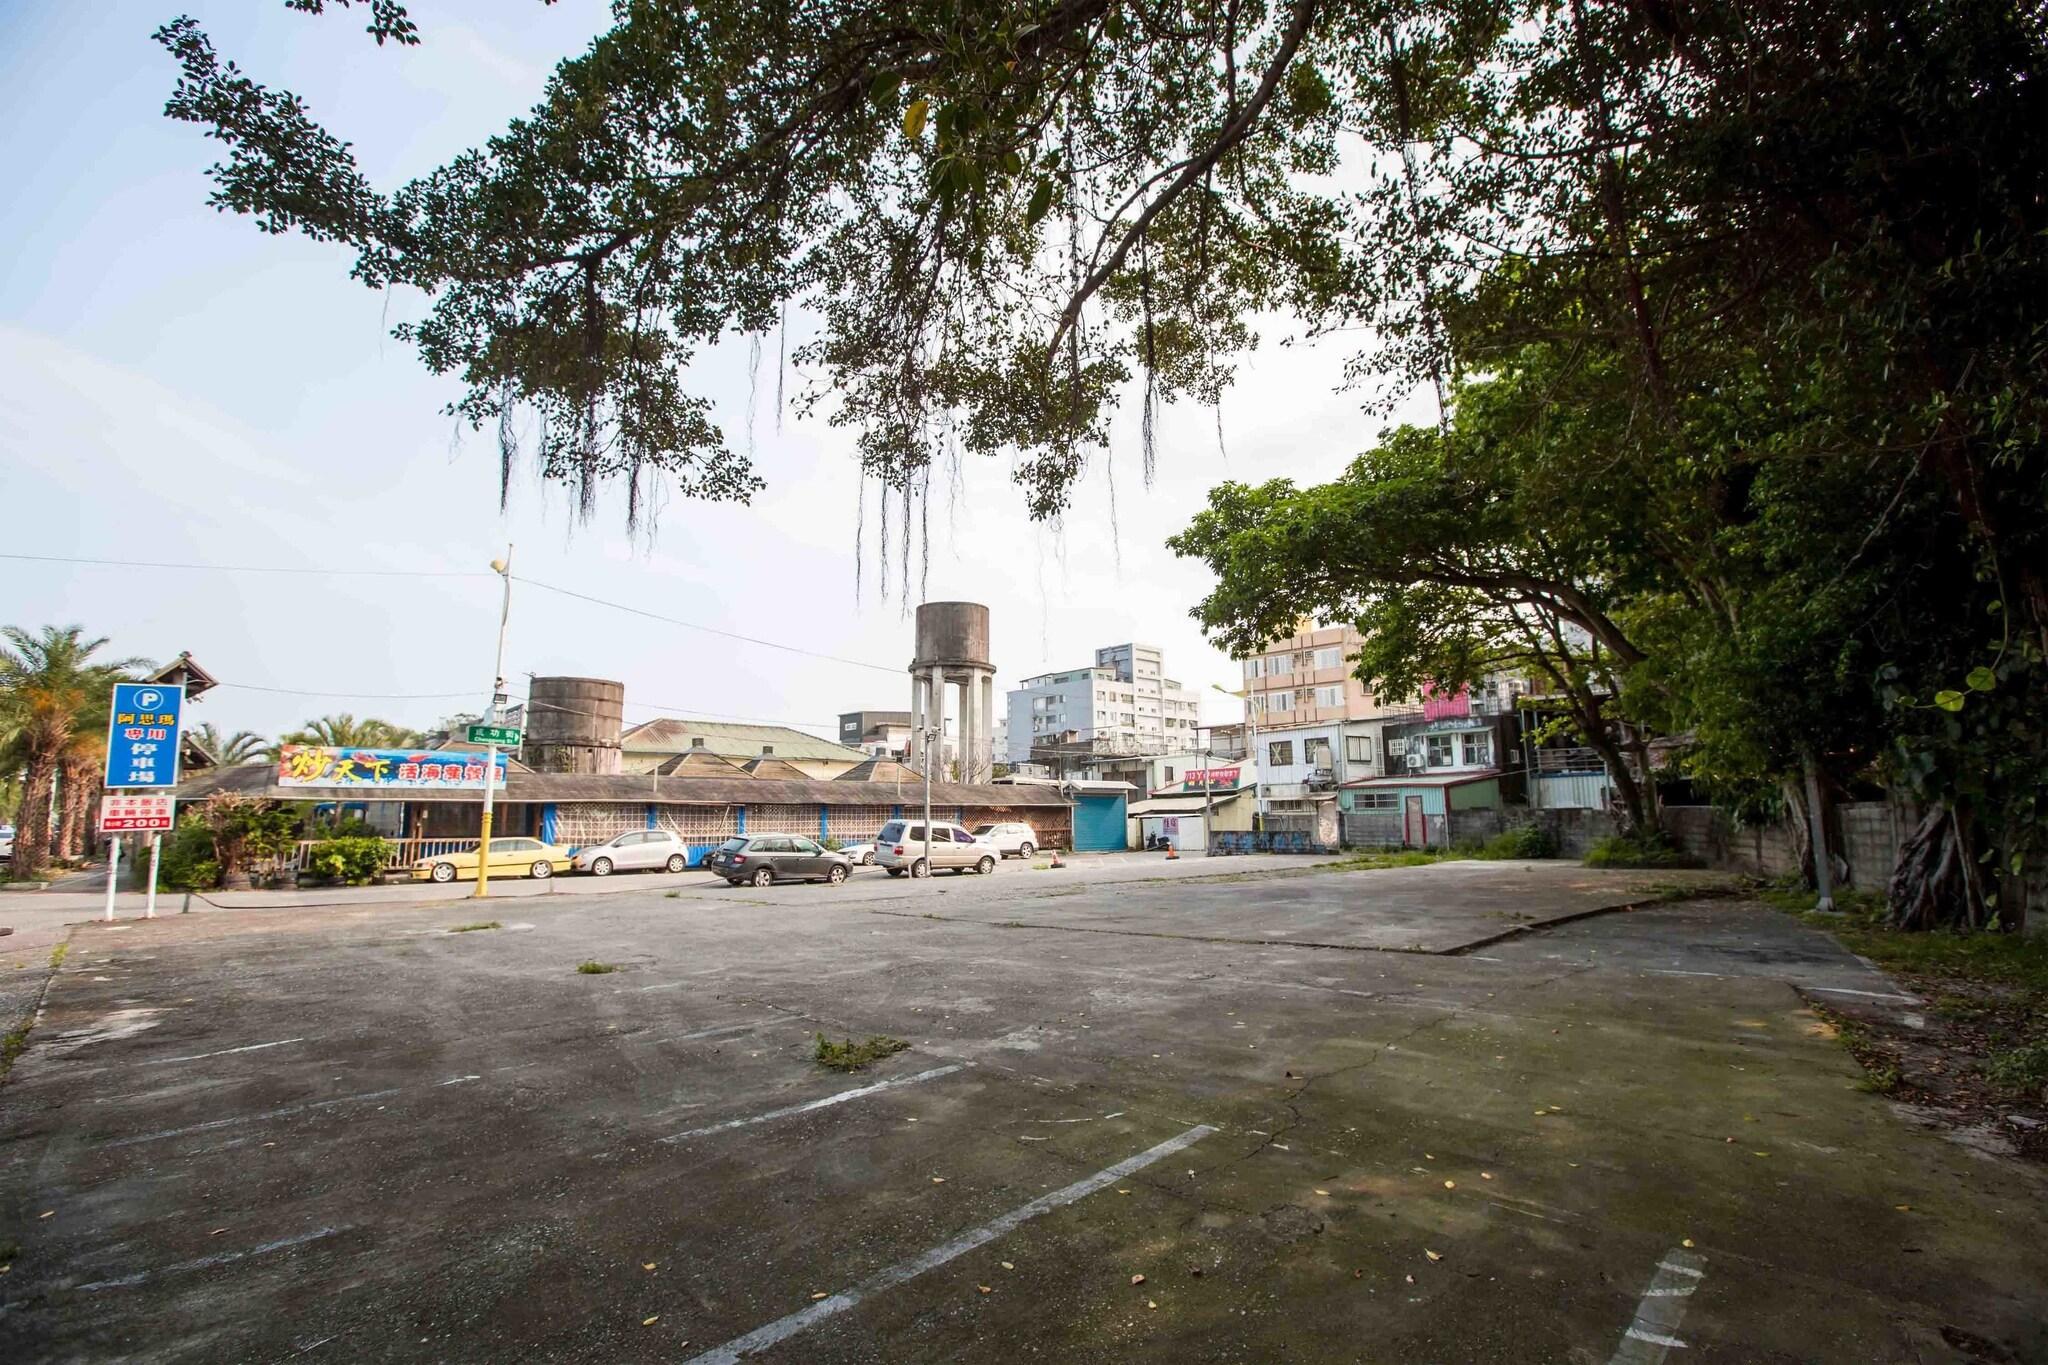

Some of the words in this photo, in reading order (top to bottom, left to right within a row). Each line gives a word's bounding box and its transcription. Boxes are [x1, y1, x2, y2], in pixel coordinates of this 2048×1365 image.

[142, 693, 158, 706] P
[117, 713, 175, 726] 阿思瑪
[124, 728, 167, 740] 專用
[128, 743, 158, 783] 停車場
[292, 751, 391, 783] 炒天下
